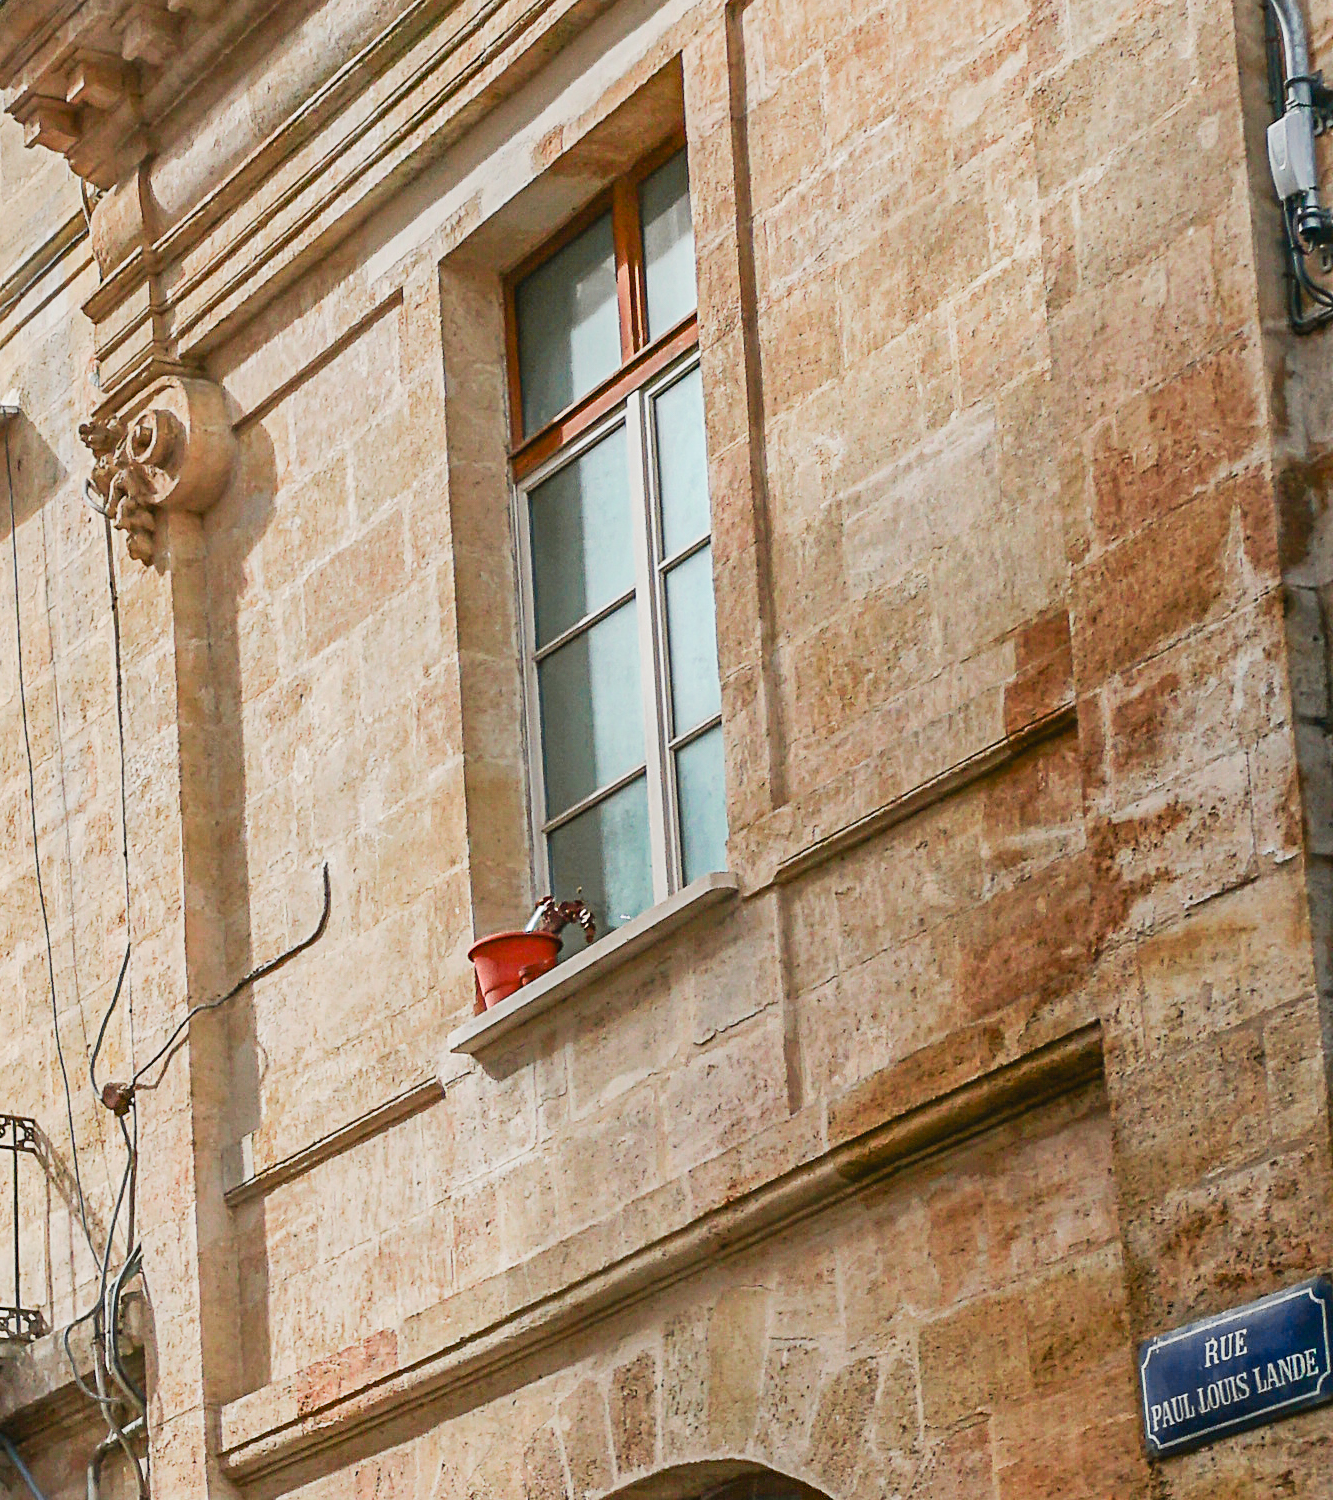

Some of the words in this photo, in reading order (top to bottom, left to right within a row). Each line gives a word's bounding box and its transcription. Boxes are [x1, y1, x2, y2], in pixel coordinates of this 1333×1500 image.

[1204, 1328, 1248, 1368] RUE
[1150, 1393, 1195, 1432] PAUL
[1197, 1371, 1250, 1414] LOUIS
[1252, 1347, 1319, 1394] LANDE
